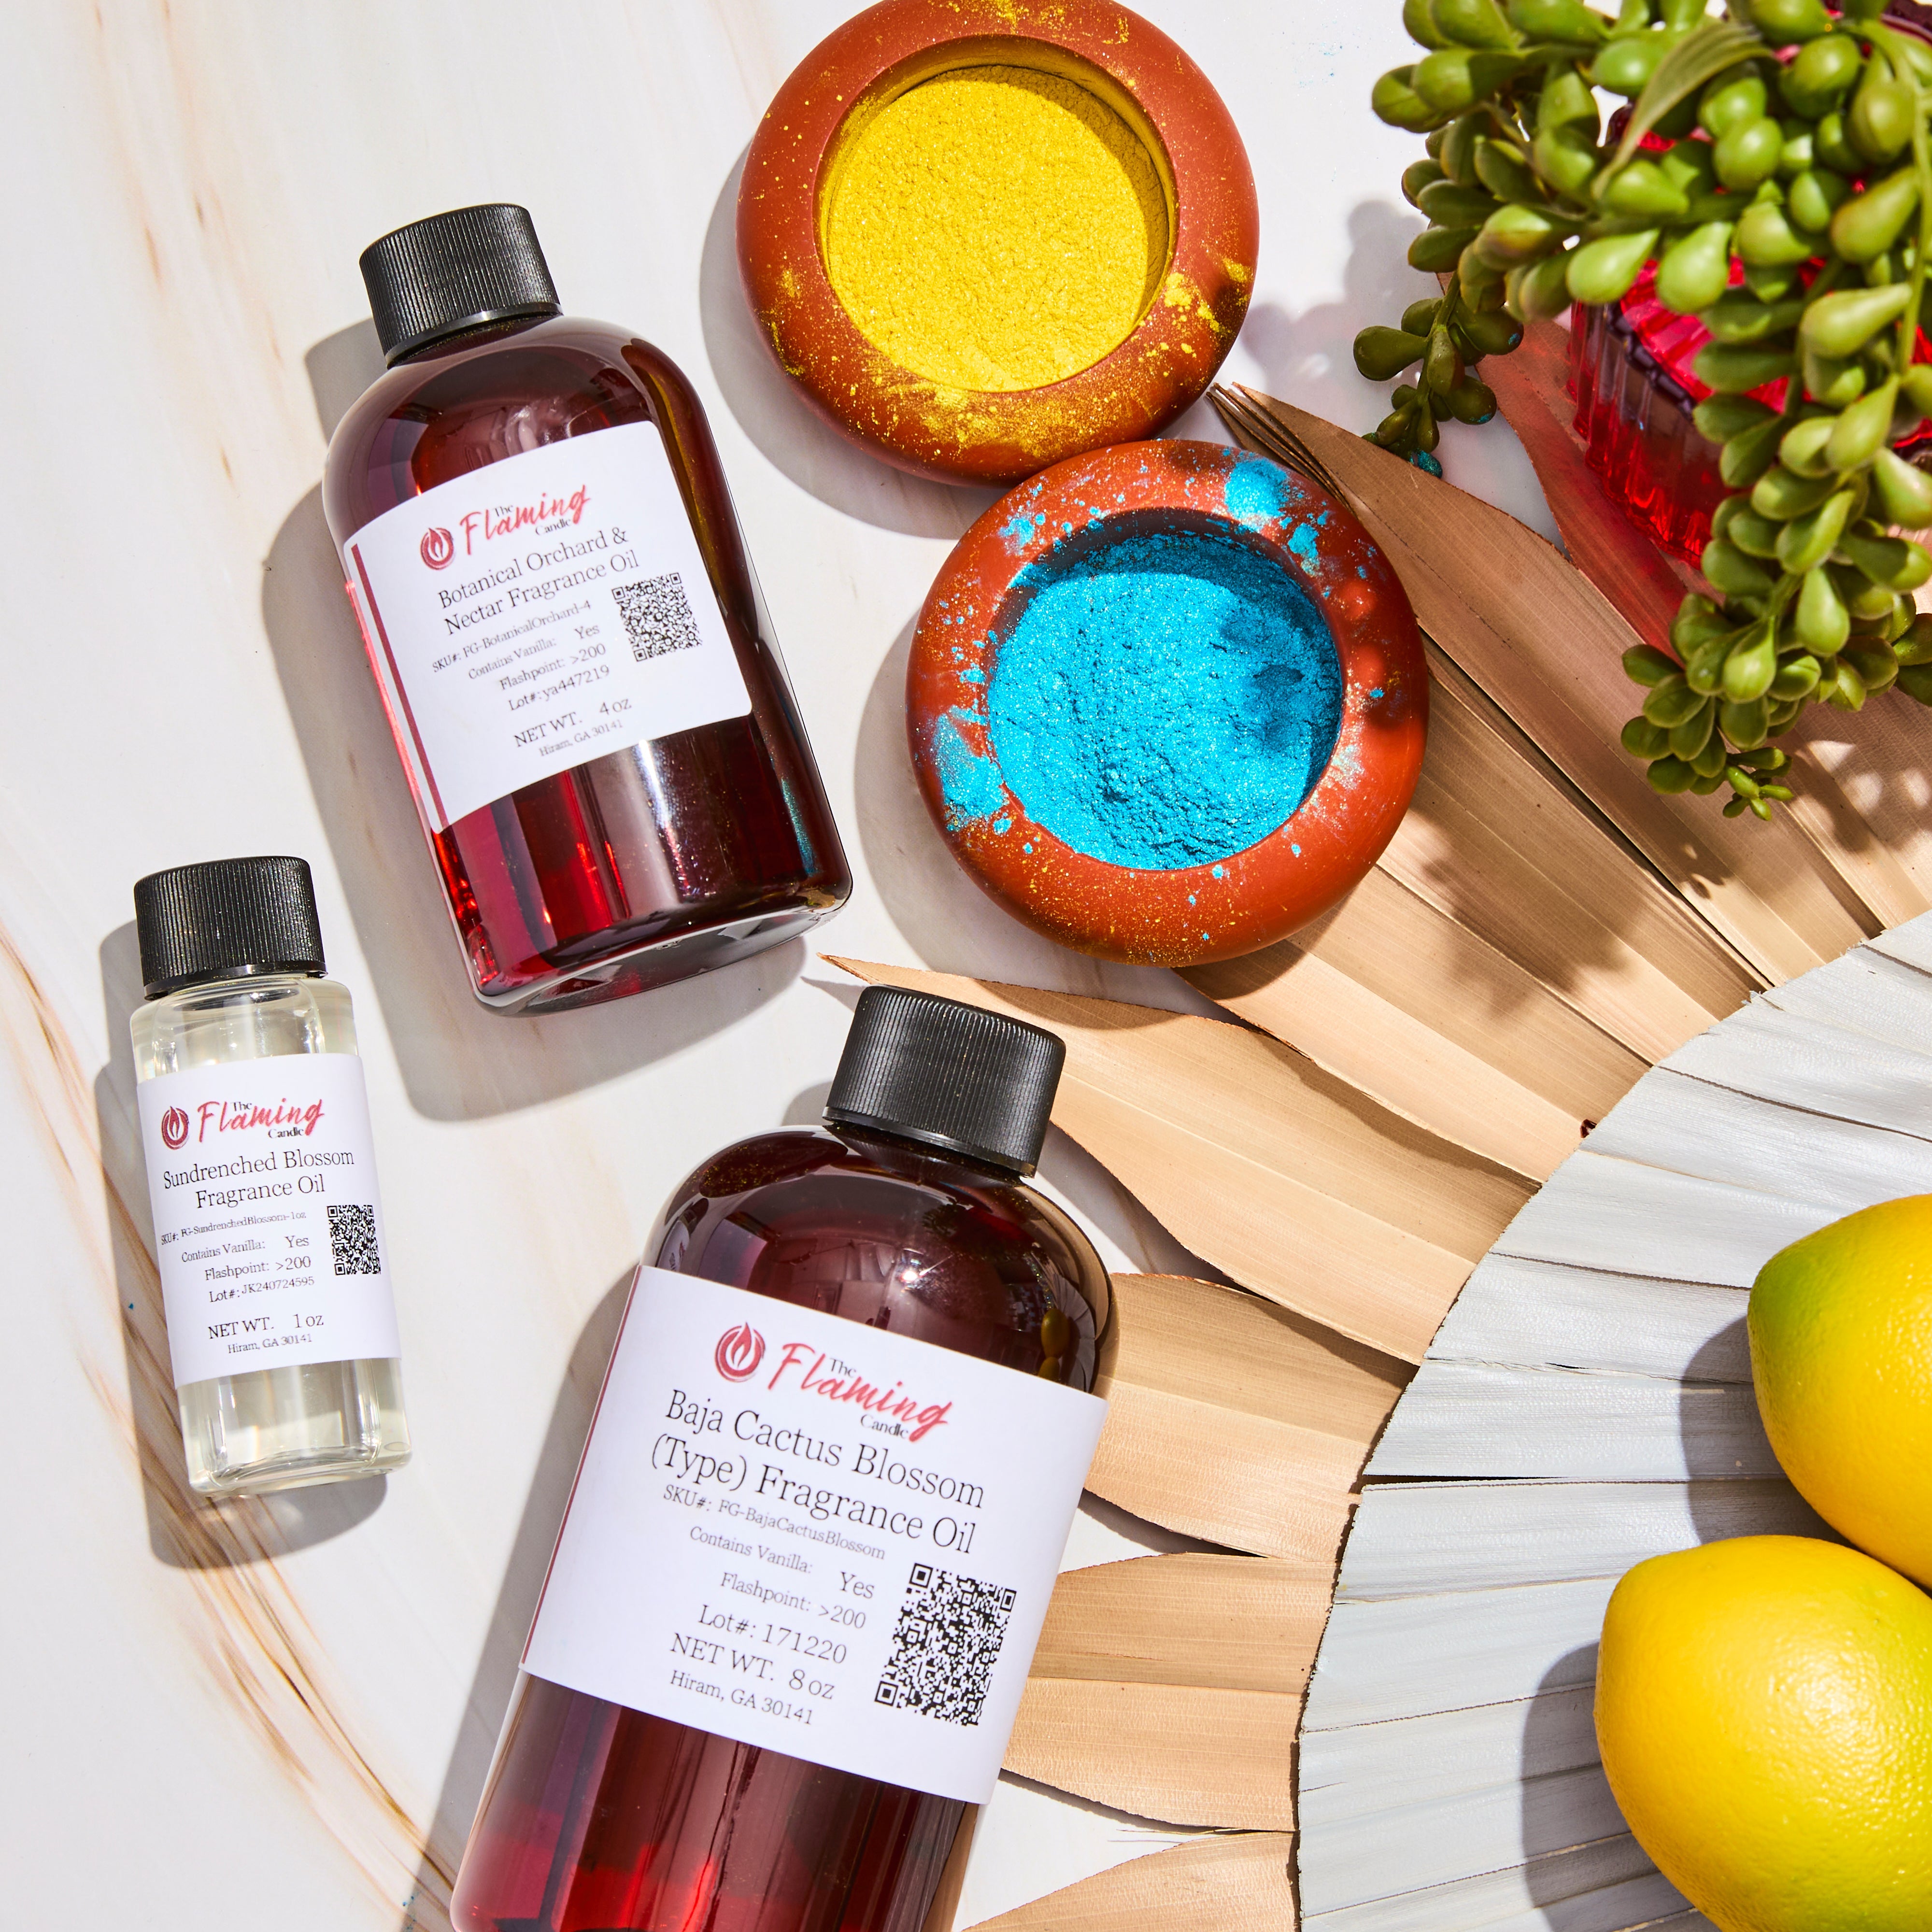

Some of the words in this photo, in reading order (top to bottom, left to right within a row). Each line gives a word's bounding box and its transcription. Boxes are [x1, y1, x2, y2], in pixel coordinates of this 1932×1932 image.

[460, 485, 589, 555] Flaming
[495, 505, 513, 518] The
[535, 518, 571, 536] Candle
[437, 558, 523, 610] Botanical
[526, 530, 609, 571] Orchard
[611, 527, 628, 545] &
[443, 599, 503, 636] Nectar
[507, 565, 607, 608] Fragrance
[610, 549, 639, 572] Oil
[432, 653, 461, 673] SKU#:
[462, 600, 591, 656] FG-BotanicalOrchard-4
[468, 655, 513, 680] Contains
[513, 639, 556, 658] Vanilla:
[574, 625, 600, 639] Yes
[499, 659, 566, 690] Flashpoint:
[571, 643, 606, 664] >200
[513, 723, 546, 748] NET
[549, 711, 582, 731] WT.
[599, 702, 609, 715] 4
[612, 698, 632, 712] oz
[539, 740, 573, 756] Hiram,
[574, 731, 591, 742] GA
[593, 719, 623, 737] 30141
[198, 1098, 324, 1142] Flaming
[268, 1126, 304, 1139] Candle
[163, 1151, 278, 1190] Sundrenched
[282, 1149, 355, 1168] Blossom
[195, 1182, 292, 1209] Fragrance
[298, 1173, 326, 1194] Oil
[181, 1247, 221, 1263] Contains
[222, 1239, 265, 1253] Vanilla:
[284, 1235, 310, 1248] Yes
[204, 1262, 270, 1281] Flashpoint:
[275, 1256, 312, 1271] >200
[207, 1321, 239, 1339] NET
[241, 1317, 274, 1333] WT.
[293, 1313, 302, 1328] 1
[305, 1315, 324, 1327] oz
[227, 1342, 260, 1354] Hiram,
[262, 1338, 279, 1348] GA
[281, 1334, 312, 1346] 30141
[768, 1343, 952, 1442] Flaming
[830, 1358, 856, 1377] The
[665, 1389, 723, 1435] Baja
[734, 1410, 842, 1466] Cactus
[851, 1443, 984, 1509] Blossom
[860, 1414, 909, 1439] Candle
[652, 1433, 747, 1492] (Type)
[754, 1463, 923, 1539] Fragrance
[932, 1517, 976, 1554] Oil
[663, 1484, 711, 1511] SKU#:
[718, 1499, 885, 1560] FG-BajaCactusBlossom
[690, 1526, 753, 1556] Contains
[758, 1545, 812, 1573] Vanilla:
[840, 1571, 875, 1599] Yes
[720, 1572, 811, 1611] Flashpoint:
[818, 1605, 866, 1629] >200
[698, 1604, 756, 1638] Lot#:
[762, 1624, 847, 1664] 171220
[669, 1632, 725, 1665] NET
[731, 1649, 774, 1681] WT.
[789, 1669, 806, 1690] 8
[808, 1680, 835, 1700] oz
[670, 1669, 724, 1702] Hiram,
[731, 1689, 756, 1709] GA
[761, 1697, 812, 1725] 30141
